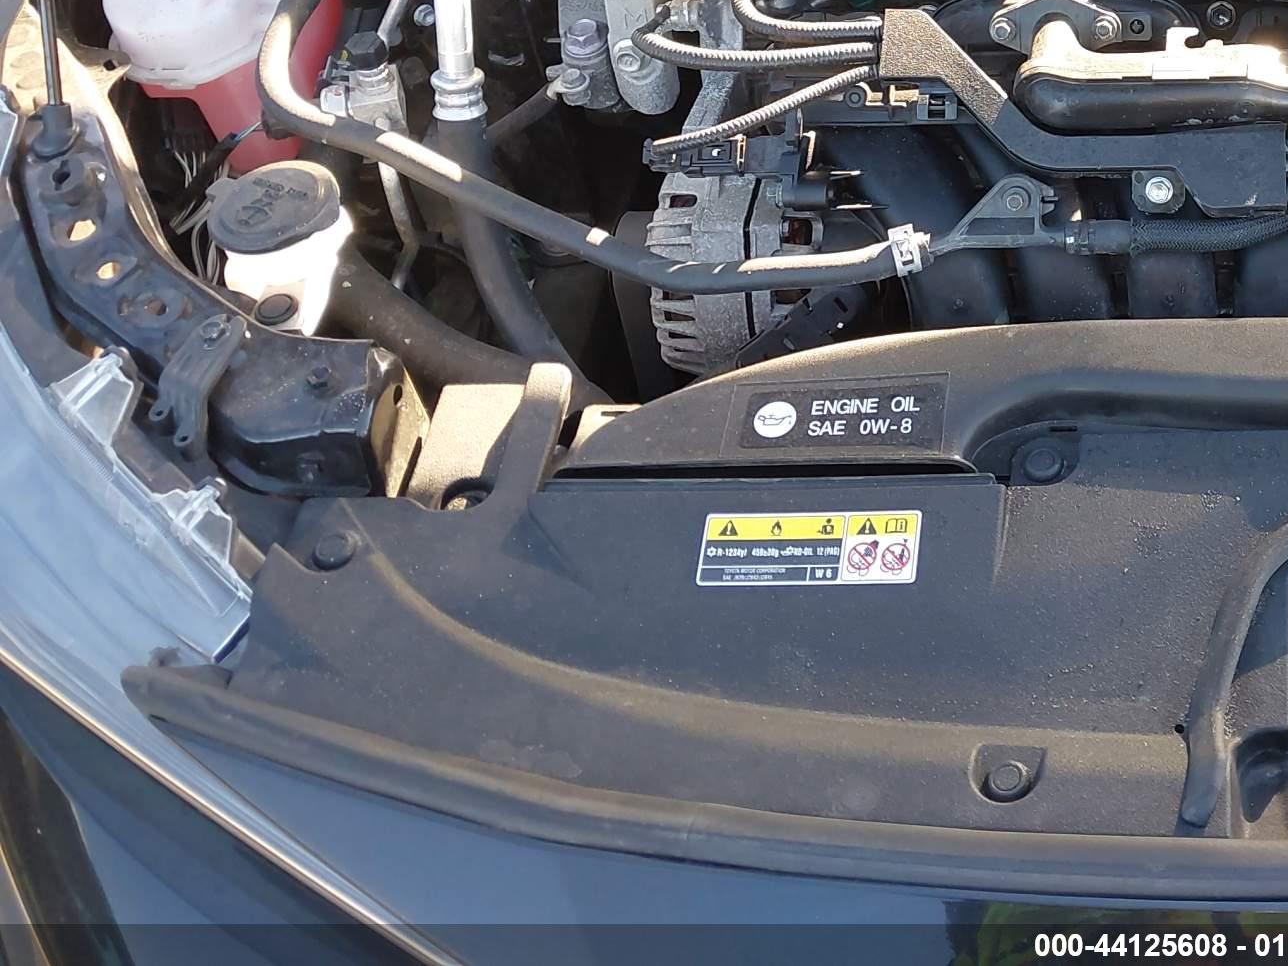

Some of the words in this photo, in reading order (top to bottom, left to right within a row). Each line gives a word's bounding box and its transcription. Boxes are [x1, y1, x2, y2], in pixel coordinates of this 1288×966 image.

[811, 398, 879, 416] ENGINE
[891, 396, 920, 413] OIL
[808, 420, 846, 436] SAE
[859, 418, 913, 435] 0W-8
[815, 568, 825, 579] W
[825, 568, 833, 579] 6
